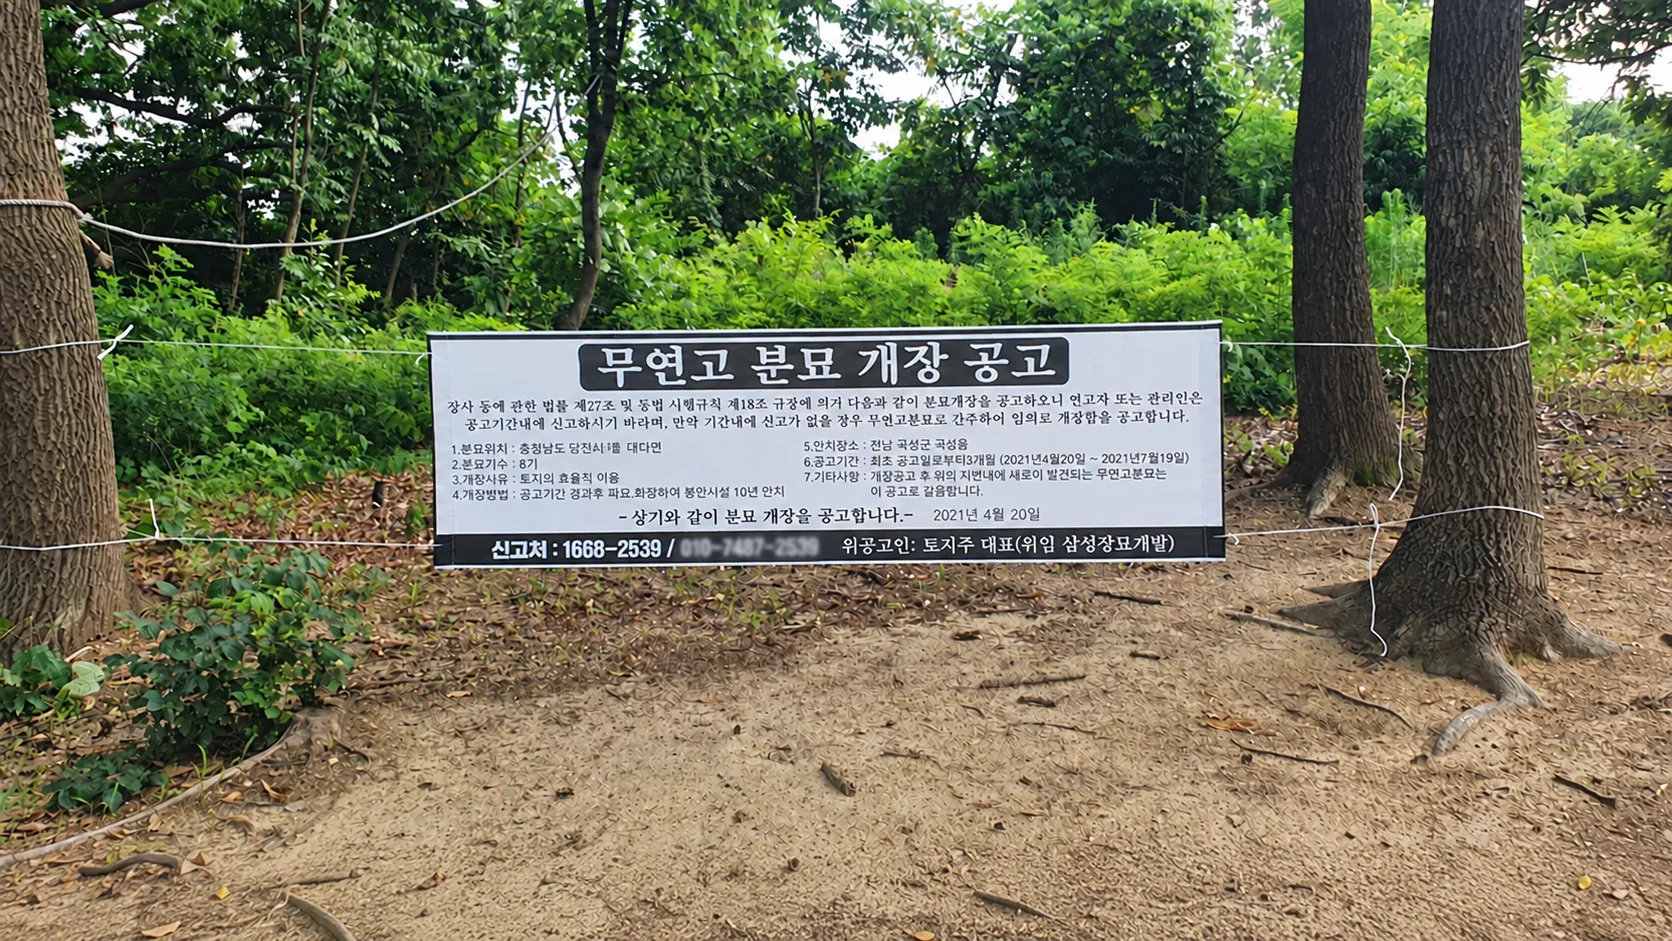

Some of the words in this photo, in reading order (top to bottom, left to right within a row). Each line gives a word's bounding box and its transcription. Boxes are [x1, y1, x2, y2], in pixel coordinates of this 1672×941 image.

[597, 344, 735, 388] 무연고
[750, 344, 842, 385] 분묘
[858, 341, 950, 386] 개장
[963, 342, 1057, 384] 공고
[447, 399, 474, 415] 장사
[510, 399, 537, 414] 관한
[573, 398, 616, 413] 제27조
[668, 397, 721, 412] 시행규칙
[727, 397, 768, 412] 제18조
[847, 395, 888, 411] 다음과
[923, 394, 992, 409] 분묘개장을
[996, 393, 1063, 408] 공고하오니
[1069, 392, 1110, 408] 연고자
[1114, 392, 1143, 406] 또는
[1147, 391, 1203, 406] 관리인은
[464, 417, 545, 432] 공고기간내에
[550, 416, 618, 431] 신고하시기
[623, 415, 668, 430] 바라며,
[672, 415, 699, 430] 만약
[704, 414, 757, 430] 기간내에
[761, 414, 801, 429] 신고가
[806, 413, 833, 428] 없을
[1011, 411, 1053, 426] 임의로
[1057, 410, 1112, 426] 개장함을
[1116, 408, 1190, 424] 공고합니다.
[451, 443, 508, 456] 1.분묘위치
[519, 442, 566, 456] 충청남도
[803, 439, 859, 453] 5.안치장소
[870, 439, 893, 452] 전남
[896, 438, 931, 452] 곡성군
[451, 458, 509, 472] 2.분묘기수
[518, 458, 538, 471] 8기
[803, 455, 860, 469] 6.공고기간
[870, 454, 893, 468] 최초
[452, 473, 509, 486] 3.개장사유
[519, 472, 555, 486] 토지의
[596, 471, 620, 485] 이용
[870, 470, 916, 484] 개장공고
[919, 470, 931, 482] 후
[933, 469, 957, 483] 위의
[1008, 468, 1043, 482] 새로이
[1046, 468, 1093, 481] 발견되는
[1096, 467, 1167, 481] 무연고분묘는
[519, 488, 566, 501] 공고기간
[570, 487, 604, 501] 경과후
[684, 486, 730, 499] 봉안시설
[734, 486, 759, 499] 10년
[761, 485, 785, 498] 안치
[870, 485, 882, 498] 이
[884, 485, 920, 498] 공고로
[724, 508, 757, 525] 분묘
[762, 507, 812, 525] 개장을
[933, 508, 978, 523] 2021년
[983, 507, 1004, 522] 4월
[1010, 507, 1040, 522] 20일
[491, 540, 547, 560] 신고처
[562, 539, 662, 559] 1668-2539
[841, 536, 916, 556] 위공고인:
[922, 535, 975, 555] 토지주
[1062, 533, 1175, 554] 삼성장묘개발)
